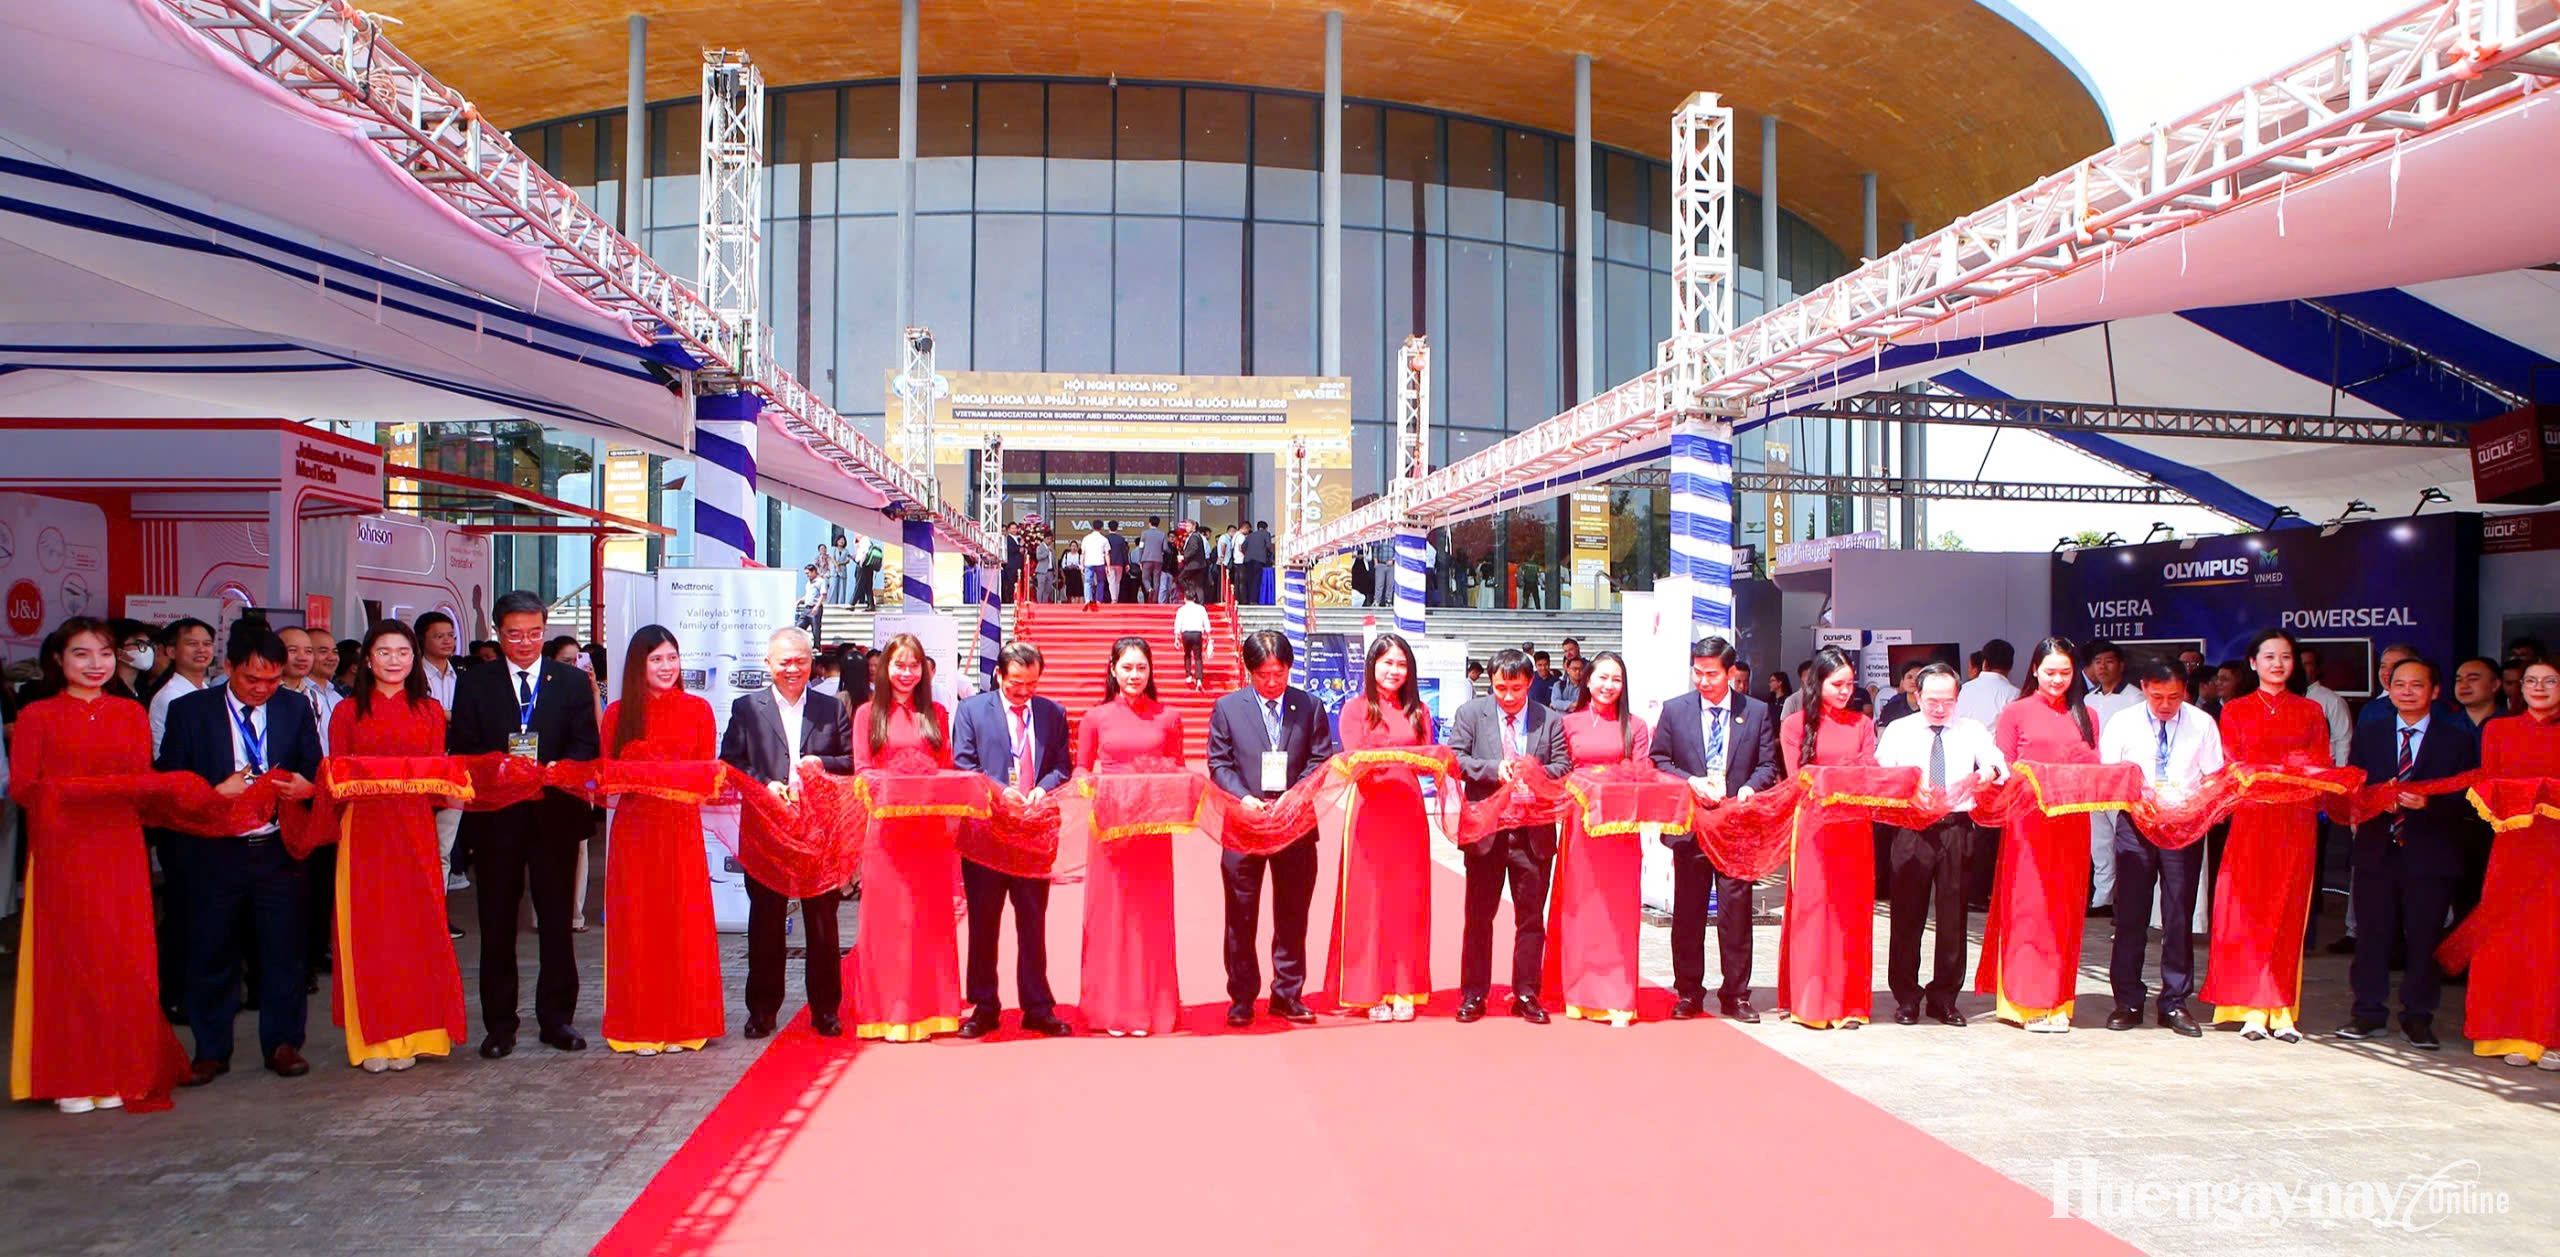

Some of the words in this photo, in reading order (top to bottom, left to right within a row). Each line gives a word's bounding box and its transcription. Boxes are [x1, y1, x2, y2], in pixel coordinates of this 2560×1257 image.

[1064, 378, 1084, 392] HỘI
[1087, 380, 1116, 393] NGHỊ
[1117, 381, 1150, 392] KHOA
[1152, 382, 1178, 394] HỌC
[952, 394, 989, 407] NGOẠI
[991, 395, 1025, 405] KHOA
[1026, 392, 1043, 405] VÀ
[1078, 394, 1115, 408] THUẬT
[1118, 395, 1138, 409] NỘI
[1139, 398, 1161, 408] SOI
[1162, 396, 1193, 408] TOÀN
[1195, 396, 1230, 409] QUỐC
[1259, 399, 1288, 409] 2026
[955, 410, 988, 418] VIETNAM
[989, 411, 1038, 419] ASSOCIATION
[1039, 411, 1053, 419] FOR
[1054, 412, 1085, 420] SURGERY
[1086, 412, 1102, 420] AND
[1221, 414, 1266, 422] CONFERENCE
[2478, 440, 2515, 464] WOLF
[358, 522, 393, 545] Johnson
[2484, 525, 2516, 537] WOLF
[2163, 557, 2249, 580] OLYMPUS
[2254, 572, 2283, 584] VNMED
[671, 582, 714, 591] Medtronic
[10, 599, 40, 619] J&J
[2087, 599, 2153, 619] VISERA
[2281, 607, 2417, 629] POWERSEAL
[679, 621, 706, 631] family
[710, 621, 719, 630] of
[721, 622, 772, 633] generators
[2094, 622, 2130, 637] ELITE
[1823, 634, 1852, 642] OLYMPUS
